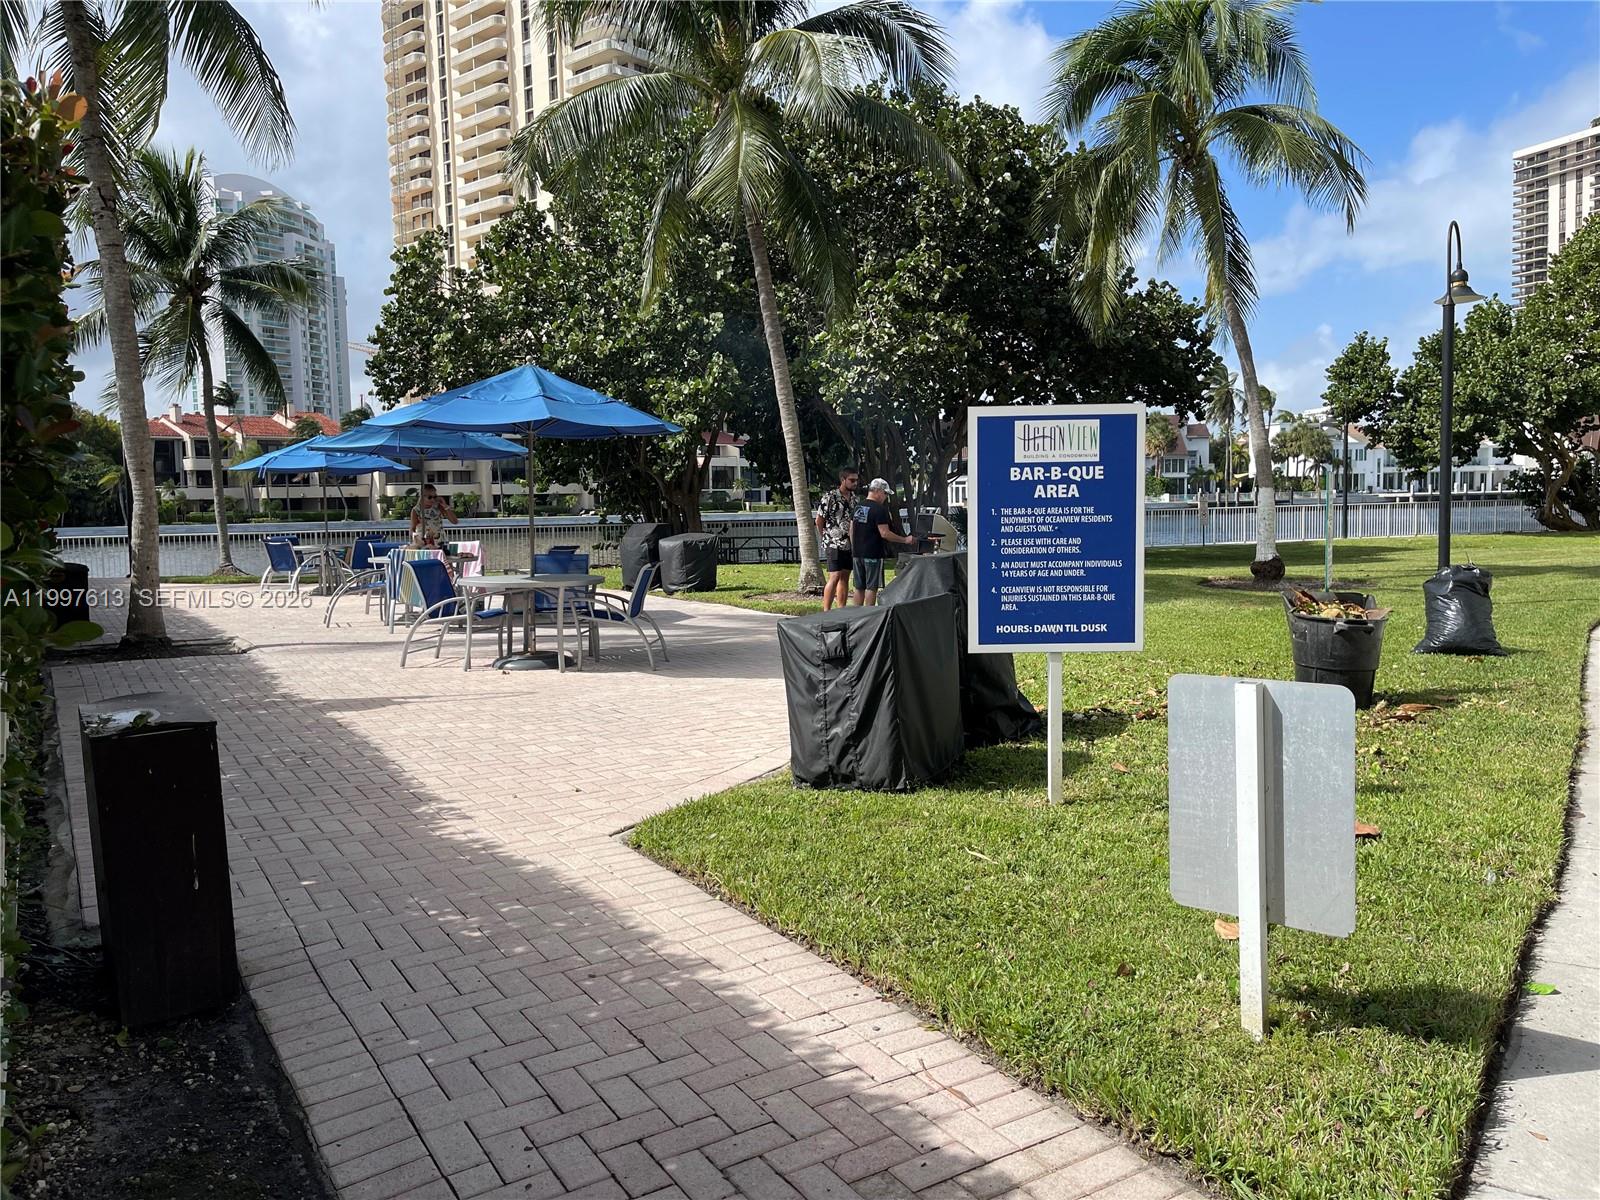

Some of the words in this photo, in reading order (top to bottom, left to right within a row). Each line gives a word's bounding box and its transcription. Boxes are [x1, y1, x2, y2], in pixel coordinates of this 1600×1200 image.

[1010, 466, 1104, 481] BAR-B-QUE
[1034, 484, 1080, 498] AREA
[1034, 625, 1063, 633] DAWN
